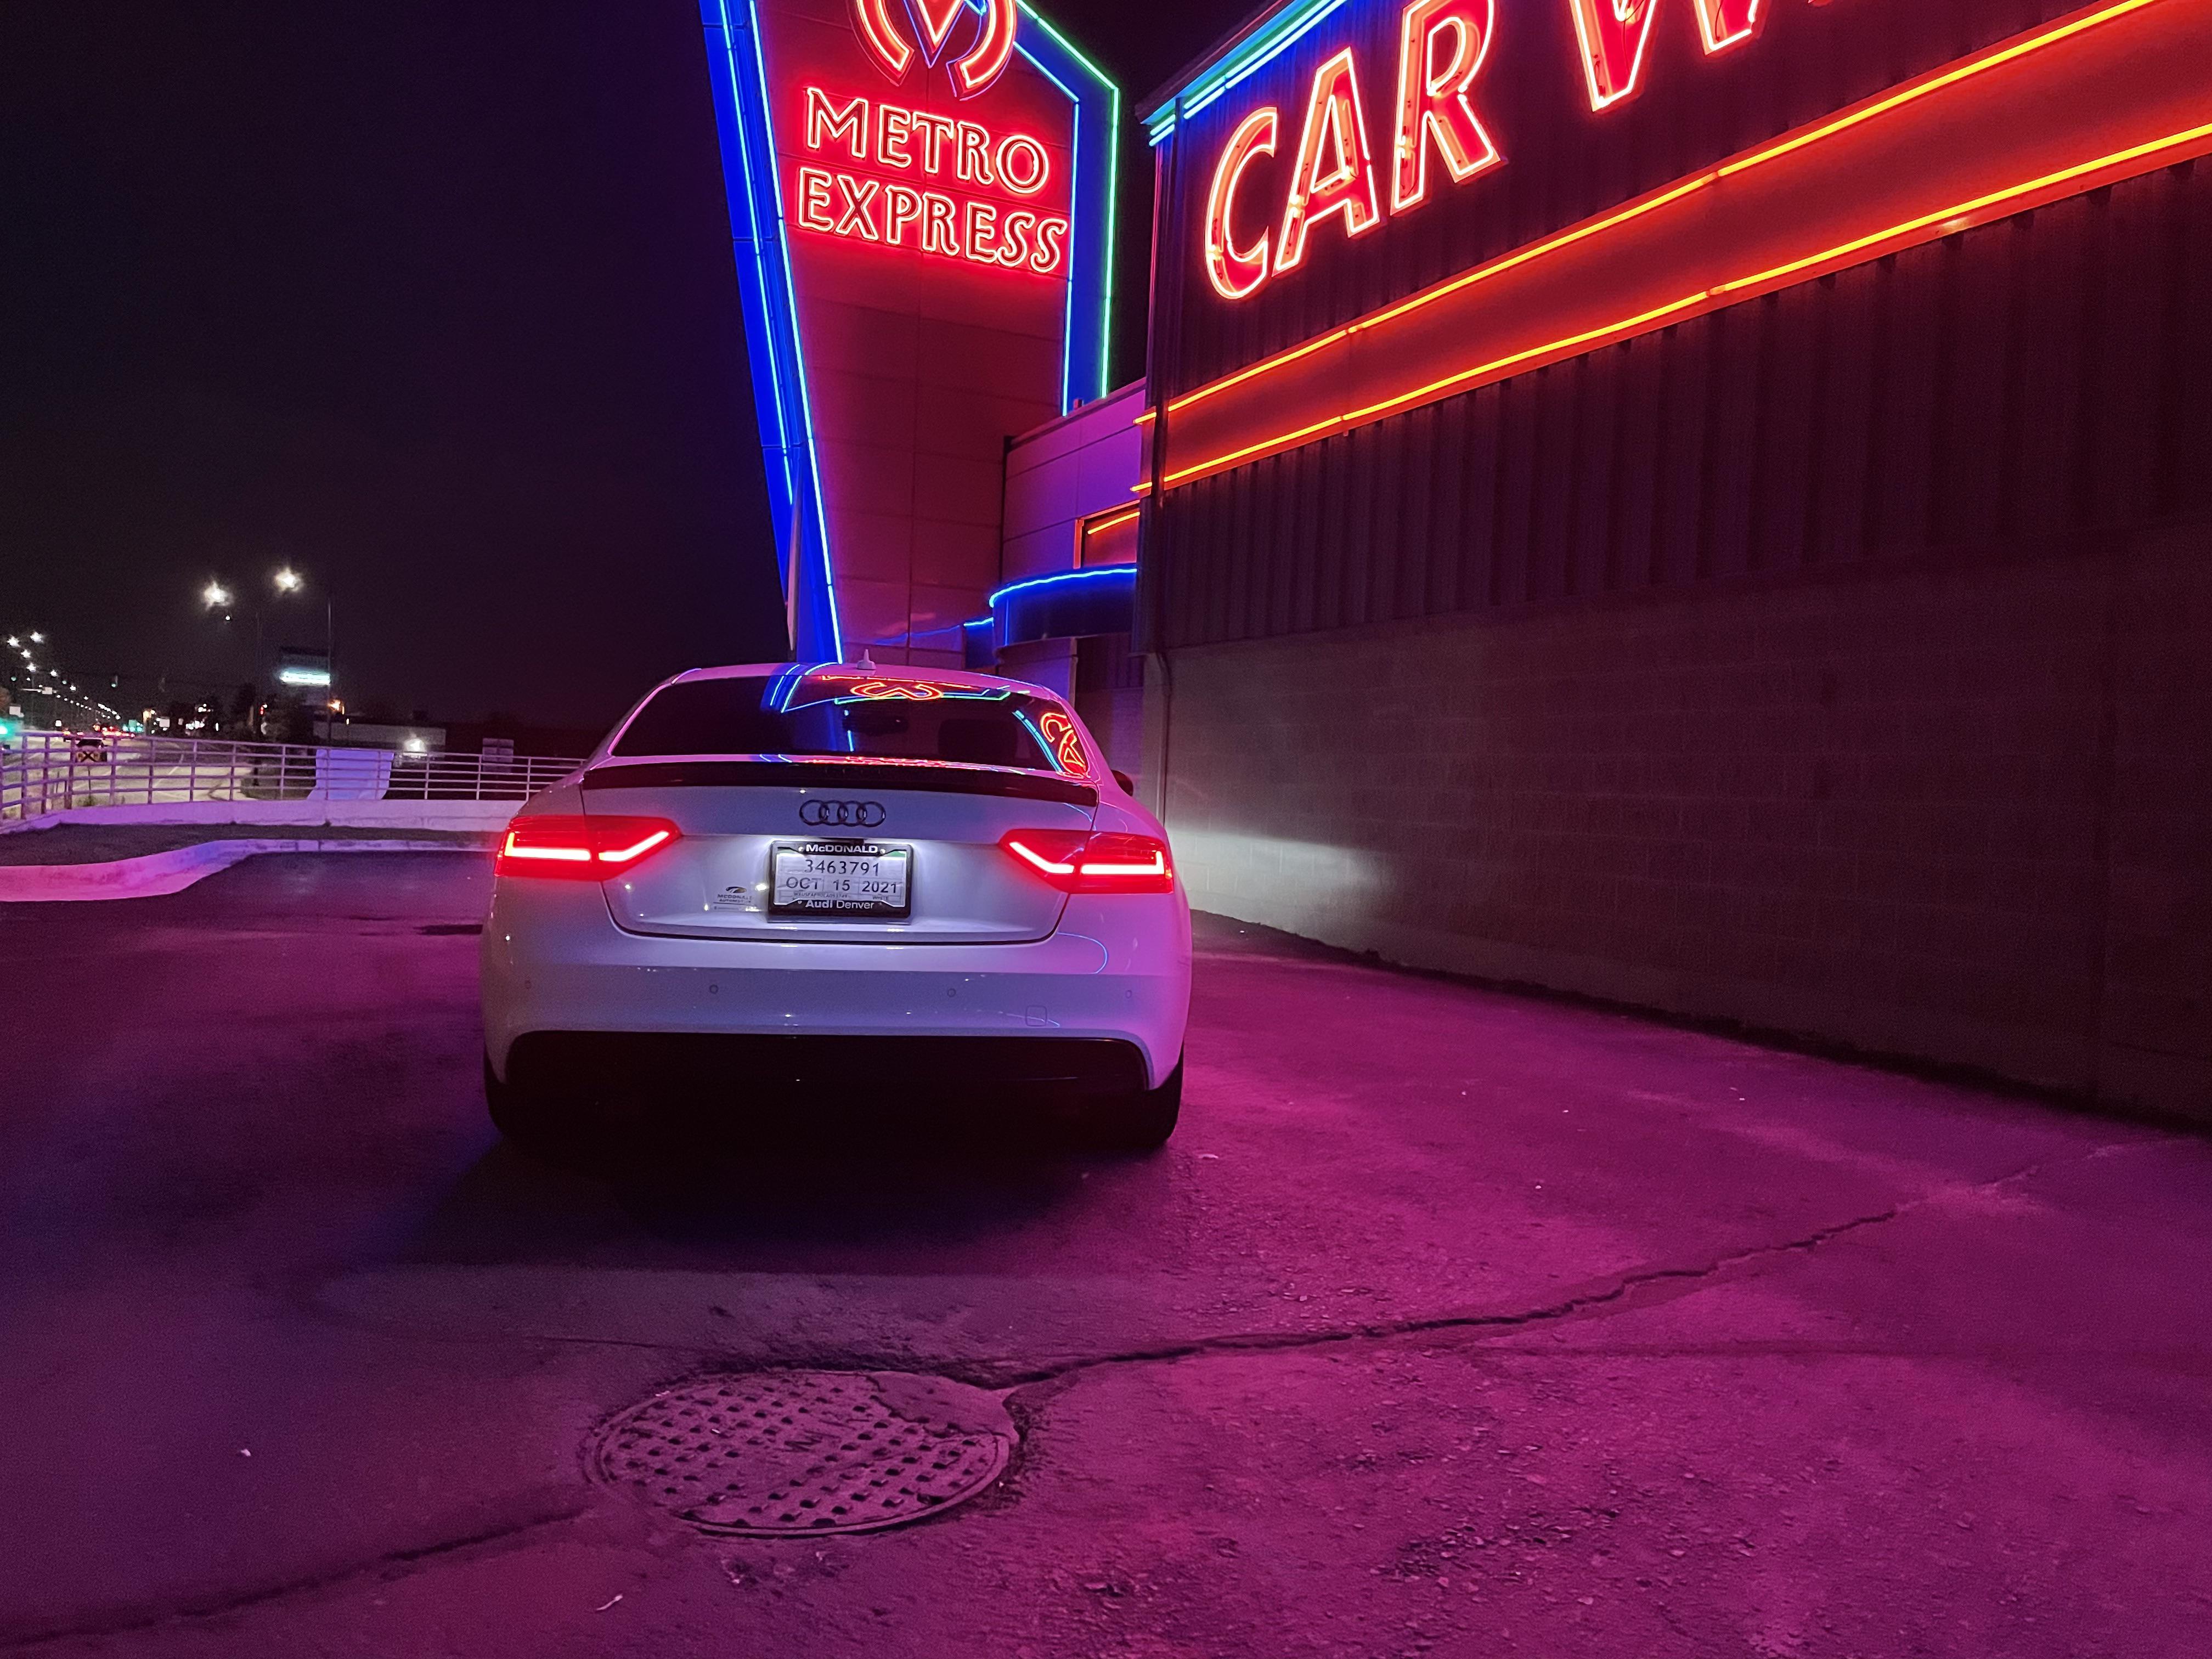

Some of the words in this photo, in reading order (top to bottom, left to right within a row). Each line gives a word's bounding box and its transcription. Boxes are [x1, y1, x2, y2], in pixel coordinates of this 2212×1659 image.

[805, 86, 1050, 195] METRO
[1205, 0, 1502, 300] CAR
[798, 167, 1068, 274] EXPRESS
[786, 876, 822, 890] OCT
[833, 879, 850, 891] 15
[861, 881, 898, 894] 2021
[804, 859, 879, 877] 3463791
[805, 900, 833, 909] Audi
[836, 900, 874, 909] Denver
